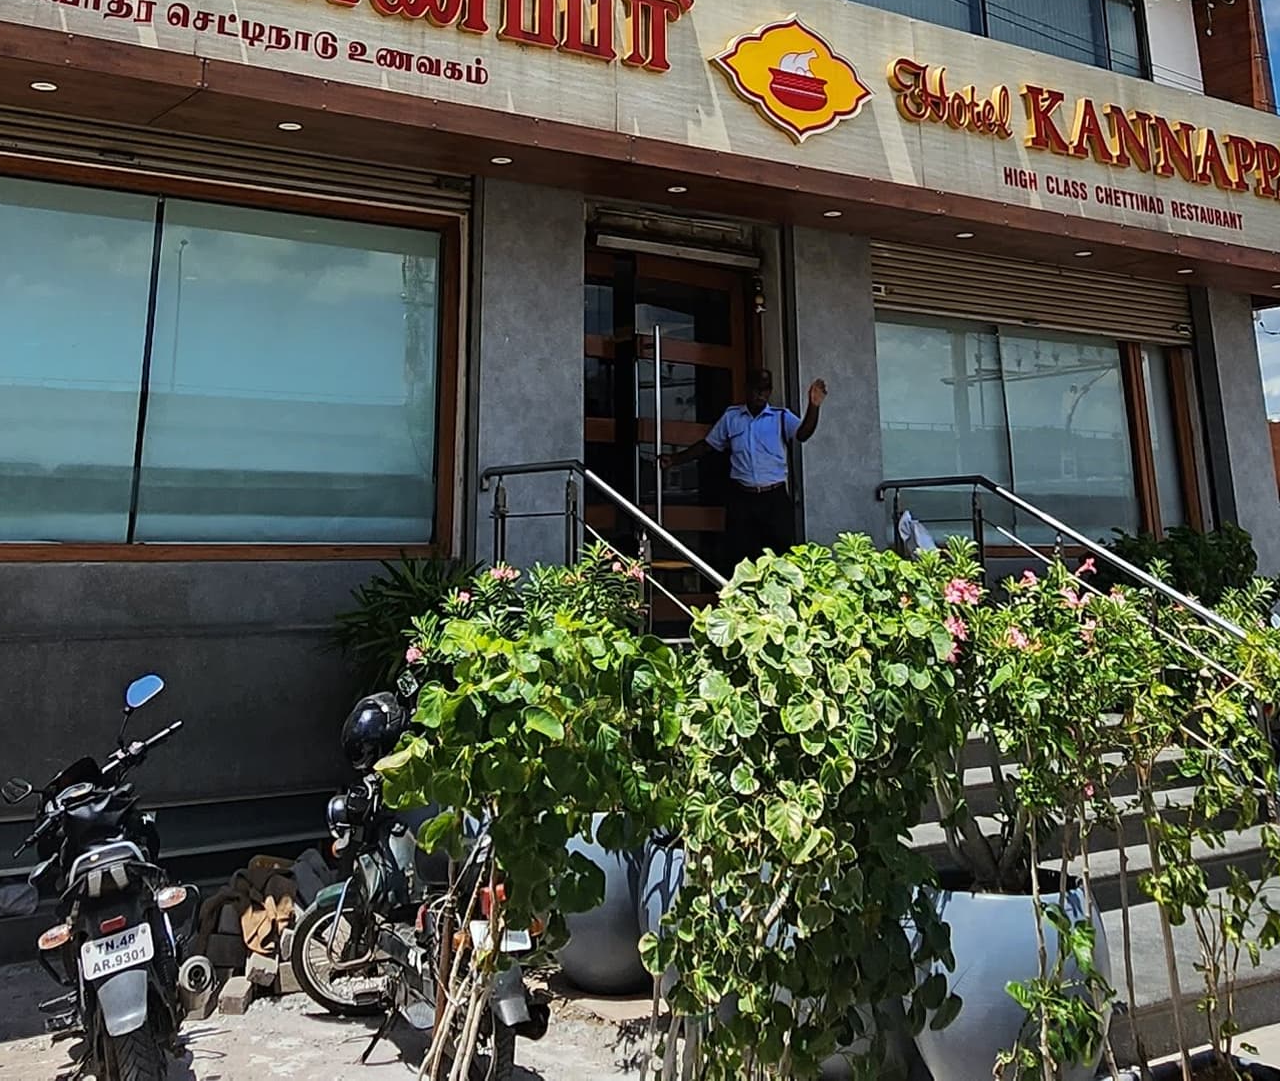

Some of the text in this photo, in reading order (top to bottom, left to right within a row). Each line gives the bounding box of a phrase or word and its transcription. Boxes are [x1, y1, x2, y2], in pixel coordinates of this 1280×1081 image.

[167, 2, 338, 59] செட்டிநாடு
[347, 40, 488, 85] உணவகம்
[886, 57, 1014, 141] Hotel
[1003, 167, 1243, 231] HIGH CLASS CHETTINAD RESTAURANT
